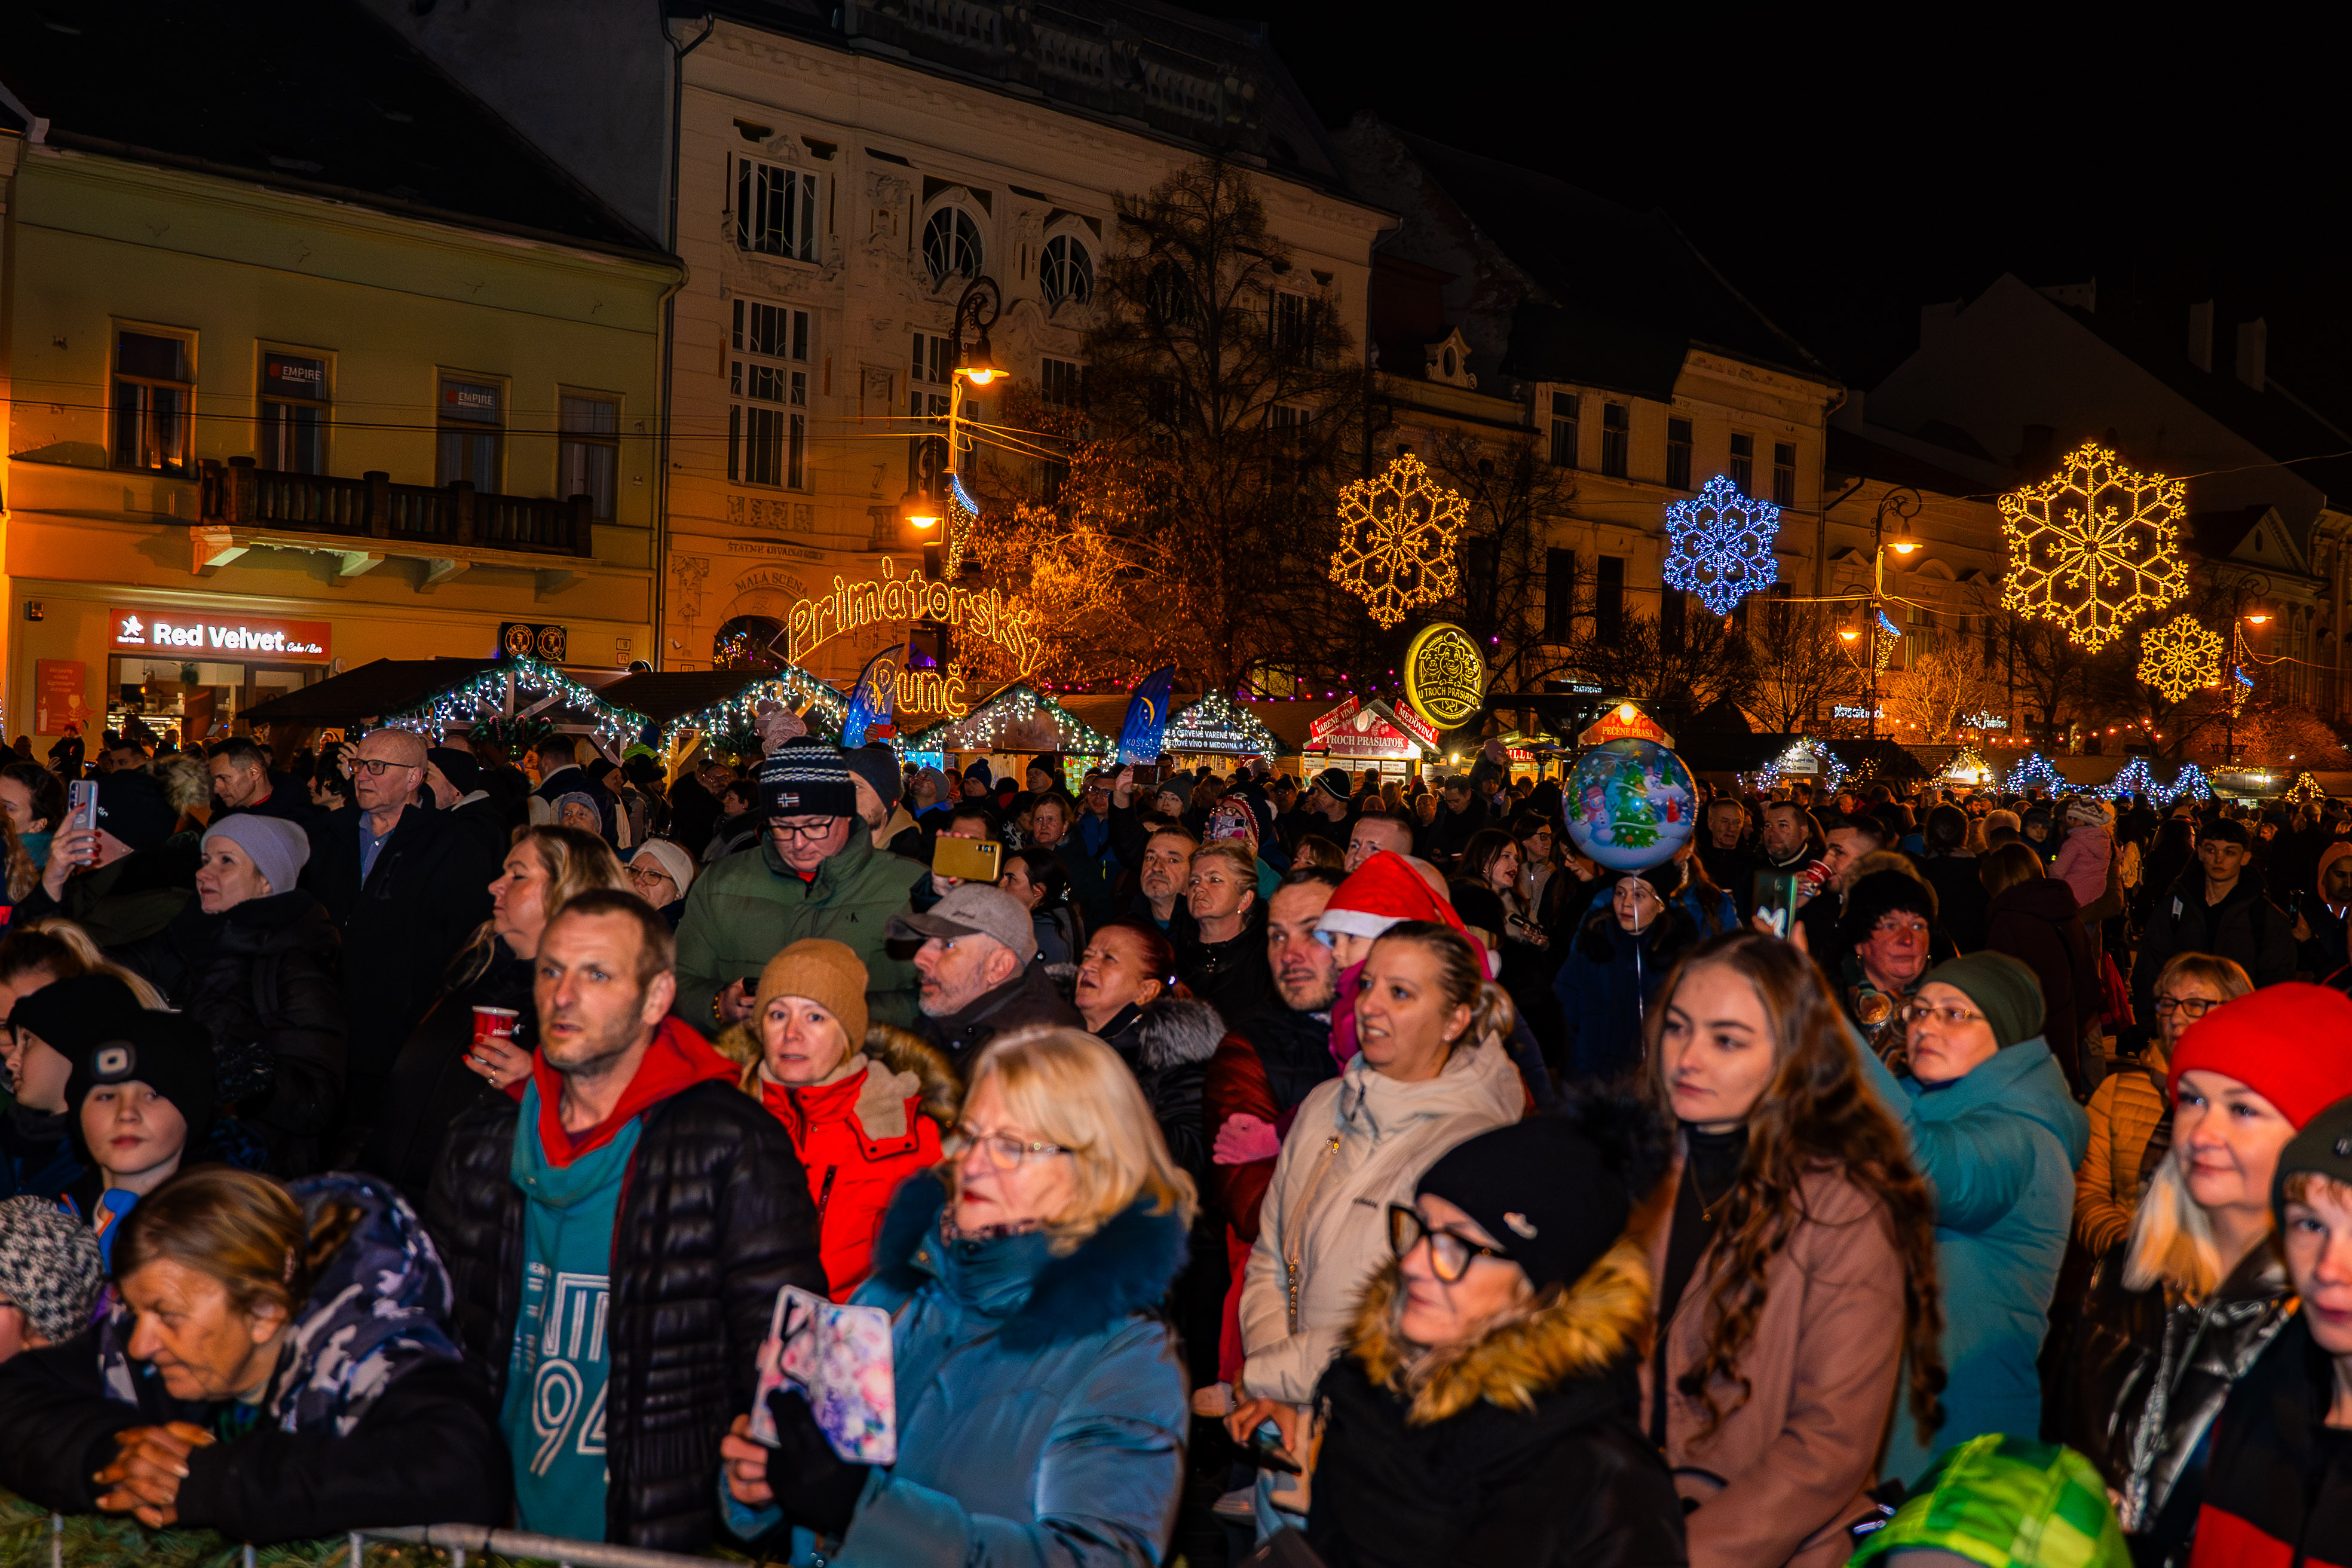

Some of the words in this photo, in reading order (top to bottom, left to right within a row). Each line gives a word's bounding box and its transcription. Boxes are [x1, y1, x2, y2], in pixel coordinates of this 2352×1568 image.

[283, 366, 322, 381] EMPIRE
[459, 392, 493, 406] EMPIRE
[787, 556, 1041, 676] Primátorský
[154, 623, 204, 647] Red
[209, 626, 286, 652] Velvet
[873, 658, 968, 716] Punč
[1418, 690, 1423, 699] U
[1425, 687, 1446, 697] TROCH
[1398, 706, 1434, 741] MEDOVINA
[1205, 730, 1228, 739] VARENÉ
[1602, 725, 1631, 736] PEČENÉ
[1632, 727, 1653, 737] PRASA
[1189, 739, 1202, 748] VÍNO
[1209, 741, 1238, 749] MEDOVINA
[1325, 734, 1355, 746] TROCH
[1357, 736, 1404, 748] PRASIATOK
